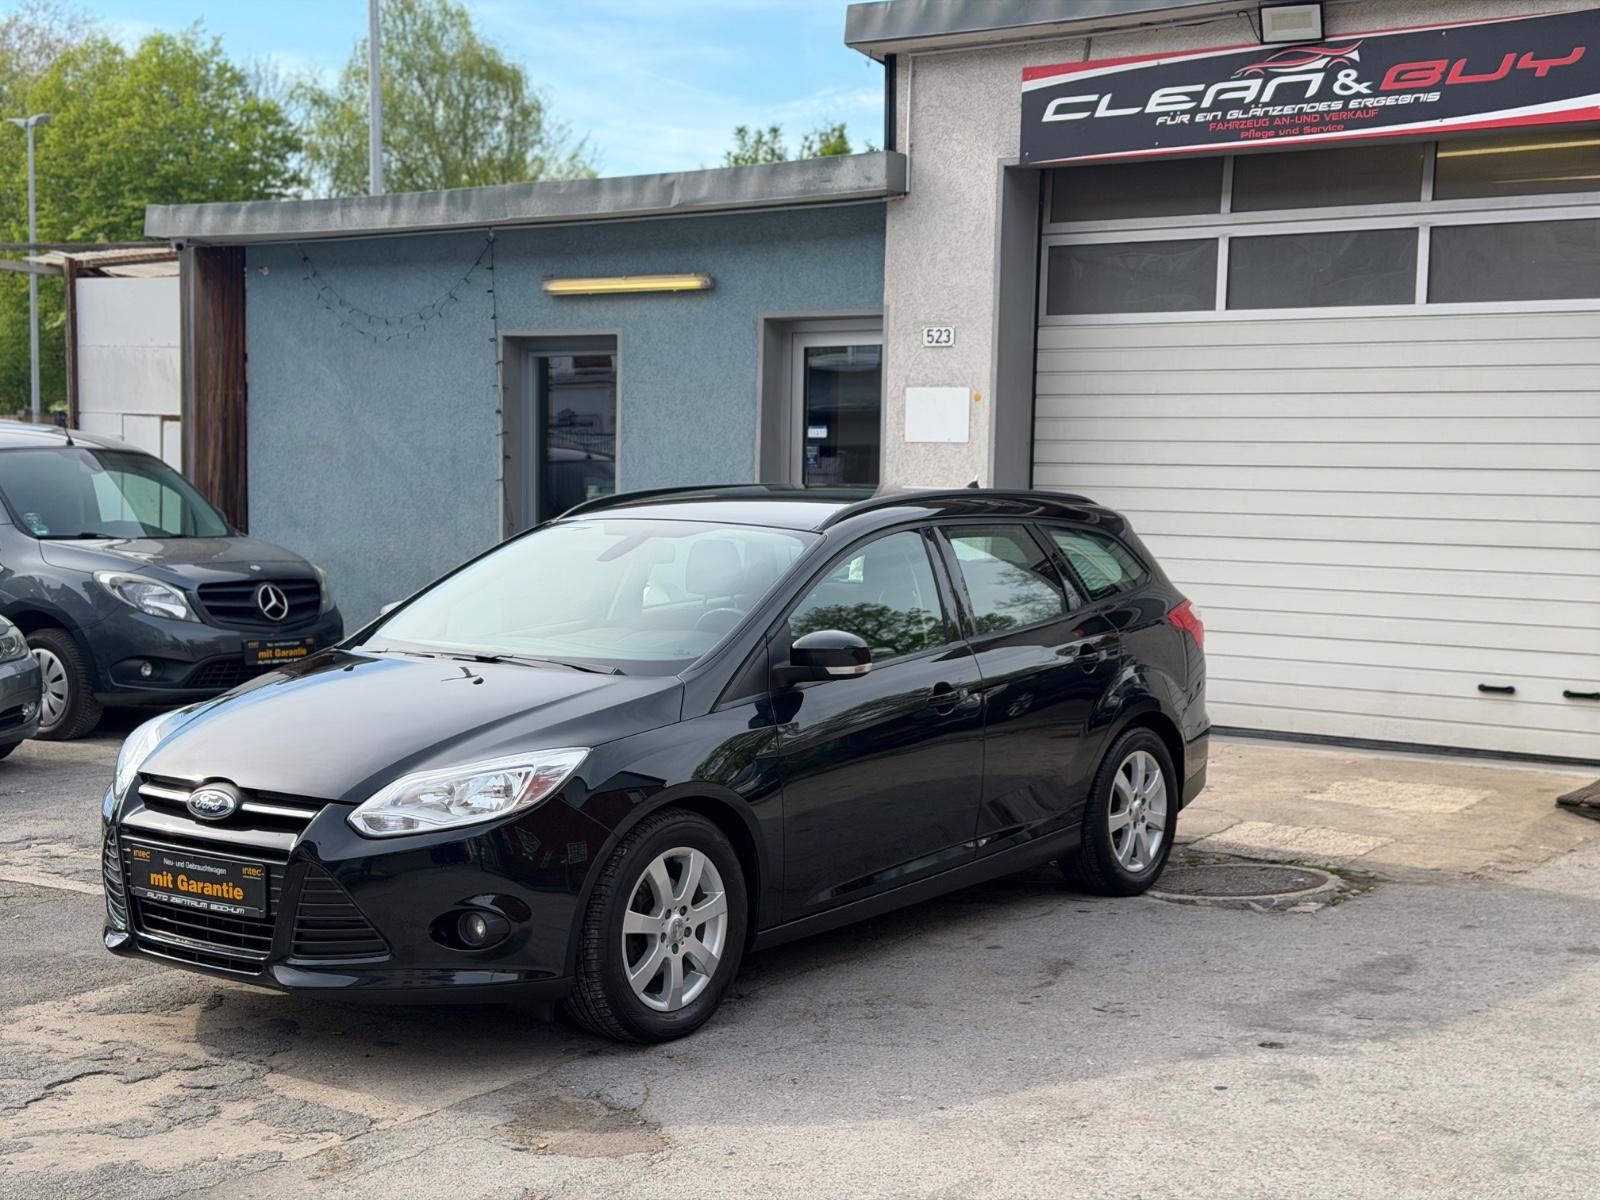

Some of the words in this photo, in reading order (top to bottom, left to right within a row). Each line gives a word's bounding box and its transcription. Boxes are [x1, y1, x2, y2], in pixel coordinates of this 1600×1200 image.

[1041, 72, 1324, 122] CLEAN
[1333, 69, 1373, 95] &
[1379, 46, 1586, 91] BUY
[1155, 112, 1190, 126] FÜR
[1195, 111, 1222, 122] EIN
[1226, 103, 1344, 120] GLÄNZENDES
[1348, 91, 1441, 109] ERGEBNIS
[1209, 118, 1269, 131] FAHRZEUG
[1273, 114, 1320, 126] AN-UND
[1323, 108, 1379, 121] VERKAUF
[1279, 127, 1299, 135] und
[1303, 124, 1344, 134] Service
[927, 329, 951, 344] 523
[258, 649, 272, 658] mit
[274, 647, 307, 657] Garantie
[195, 794, 222, 811] Ford
[163, 857, 174, 866] Neu-
[175, 860, 185, 868] und
[150, 871, 173, 888] mit
[178, 874, 244, 900] Garantie
[147, 891, 168, 901] AUTO
[170, 896, 207, 909] ZENTRUM
[210, 903, 245, 915] BOCHUM
